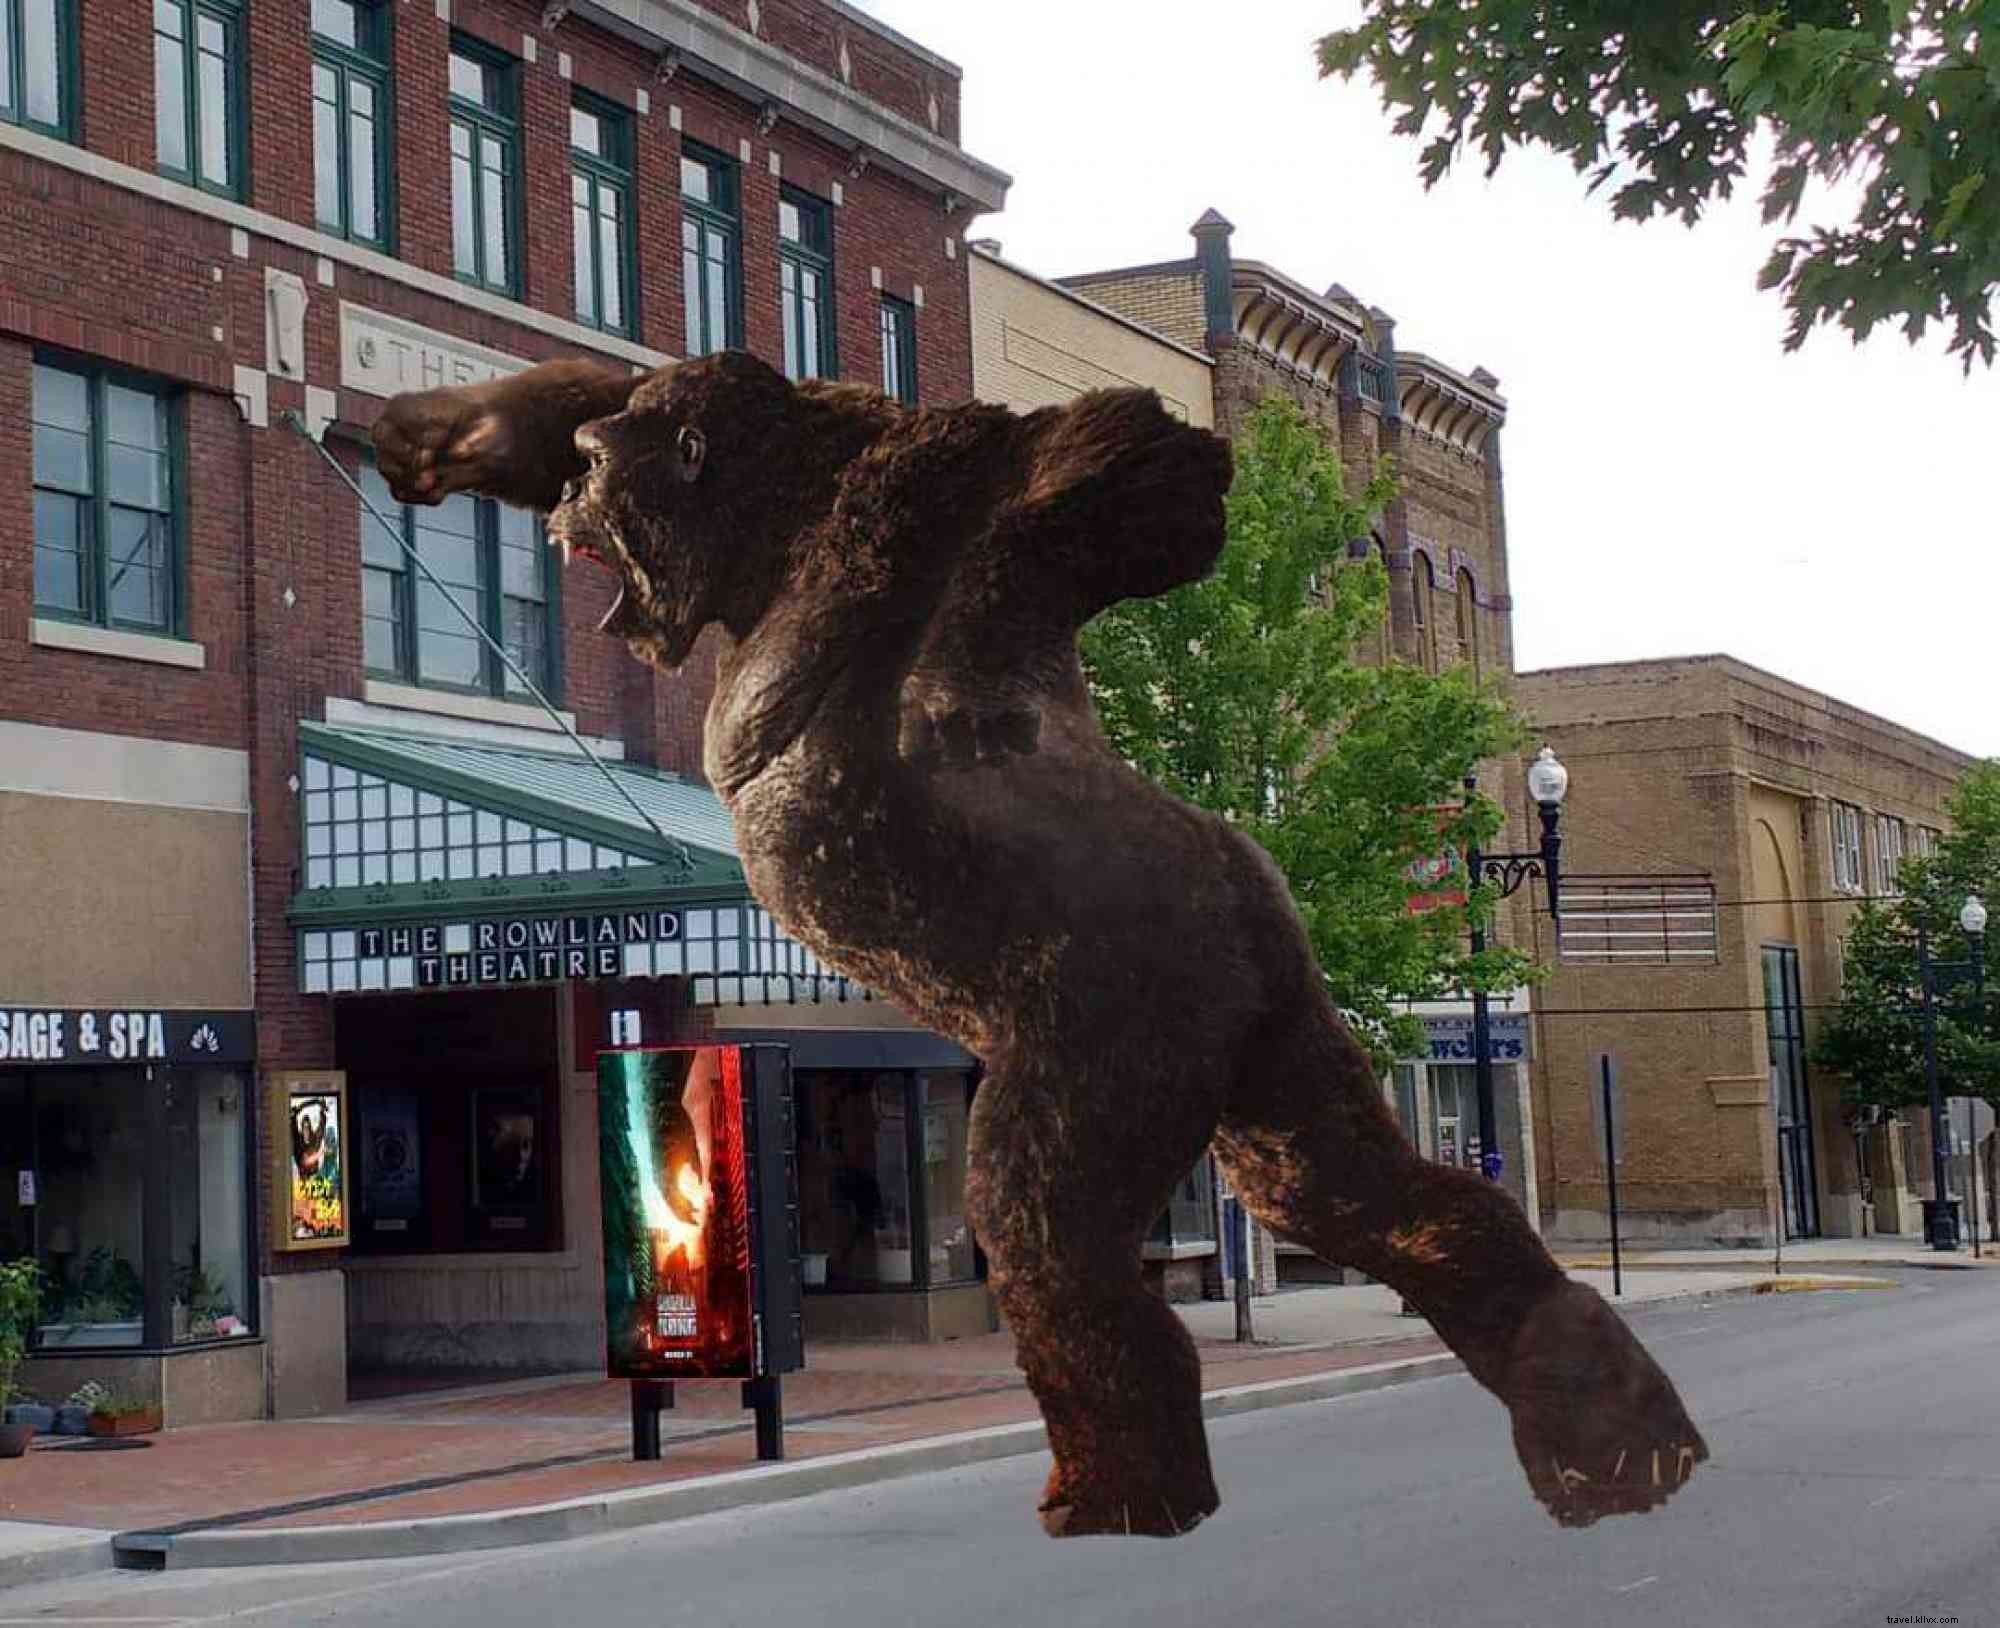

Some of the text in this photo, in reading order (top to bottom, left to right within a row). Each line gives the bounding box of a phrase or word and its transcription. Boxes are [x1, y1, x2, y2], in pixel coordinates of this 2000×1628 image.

[387, 339, 497, 388] THE
[364, 912, 679, 956] THE ROWLAND
[423, 944, 617, 984] THEATRE
[78, 1011, 100, 1052] &
[109, 1012, 166, 1060] SPA
